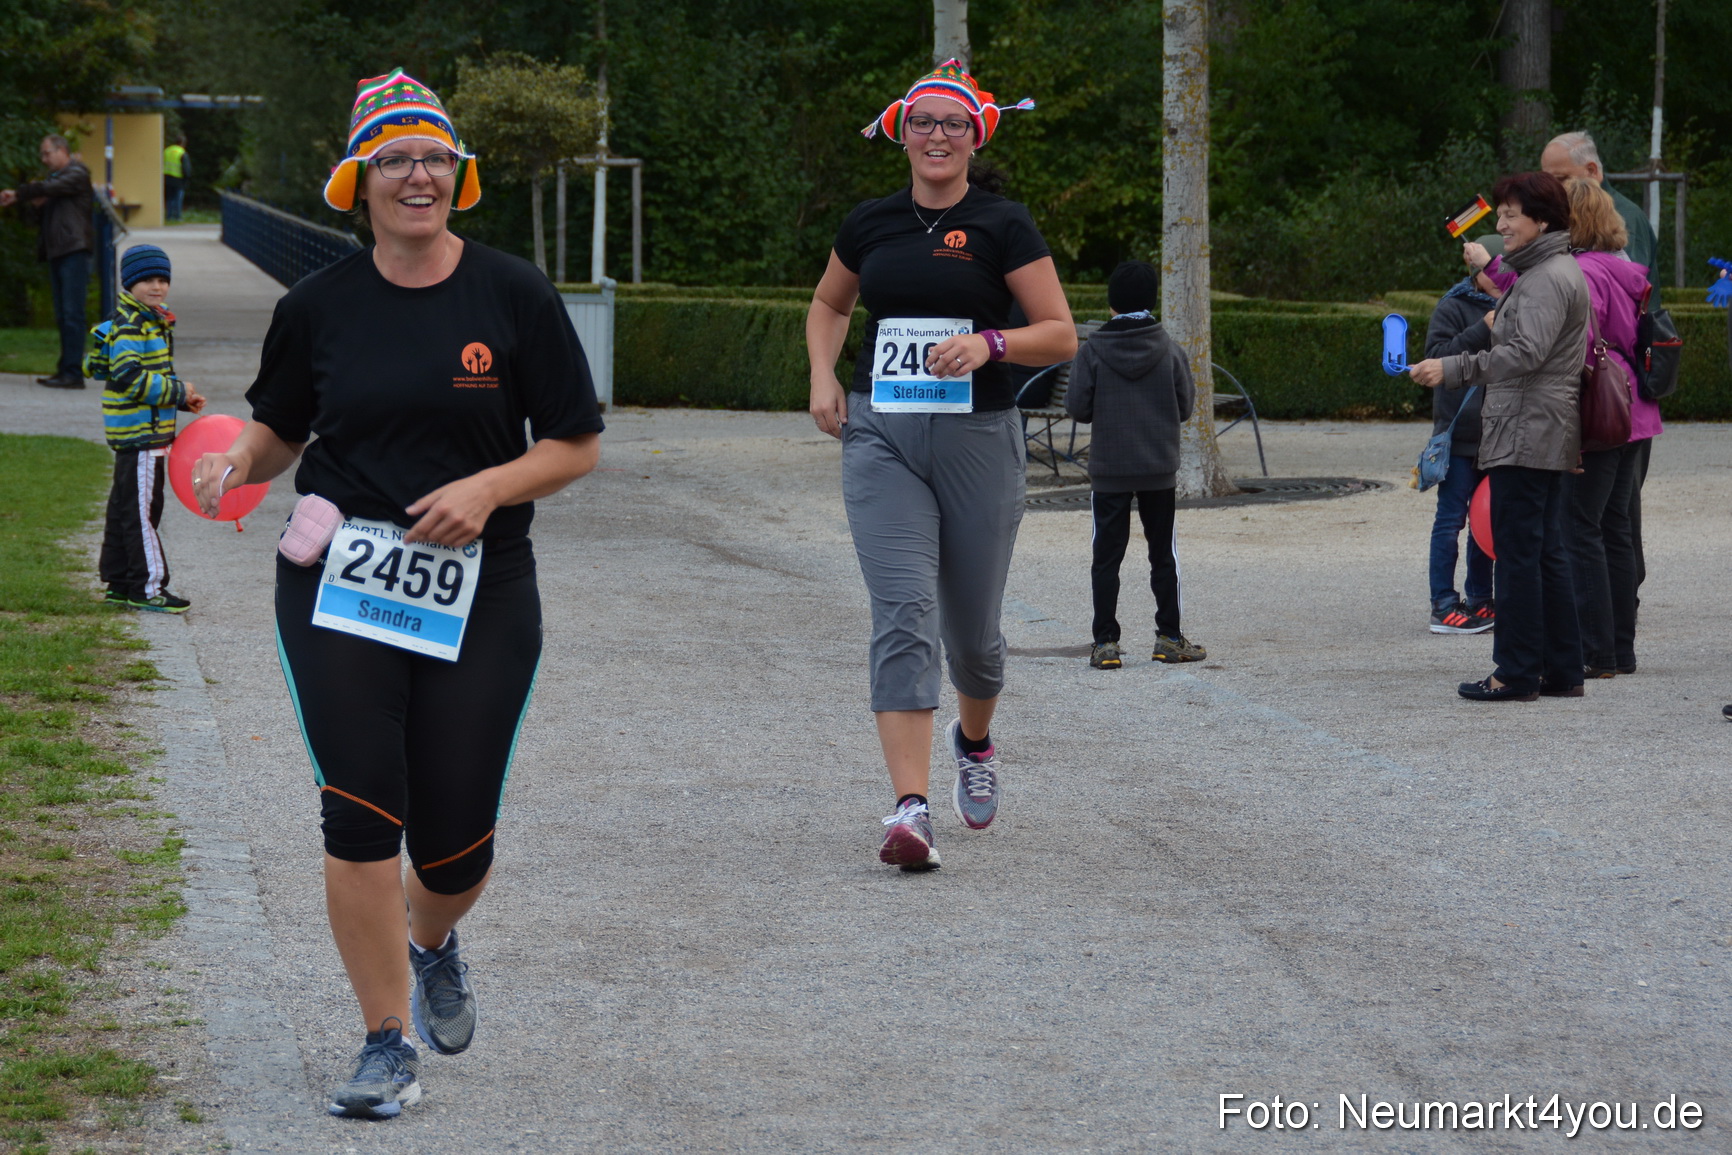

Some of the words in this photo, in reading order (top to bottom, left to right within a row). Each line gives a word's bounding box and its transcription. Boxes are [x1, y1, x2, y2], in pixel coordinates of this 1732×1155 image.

[879, 328, 904, 337] PARTL
[906, 328, 954, 337] Neumarkt
[893, 385, 947, 399] Stefanie
[342, 522, 388, 538] PARTL
[340, 538, 464, 606] 2459
[357, 599, 422, 632] Sandra
